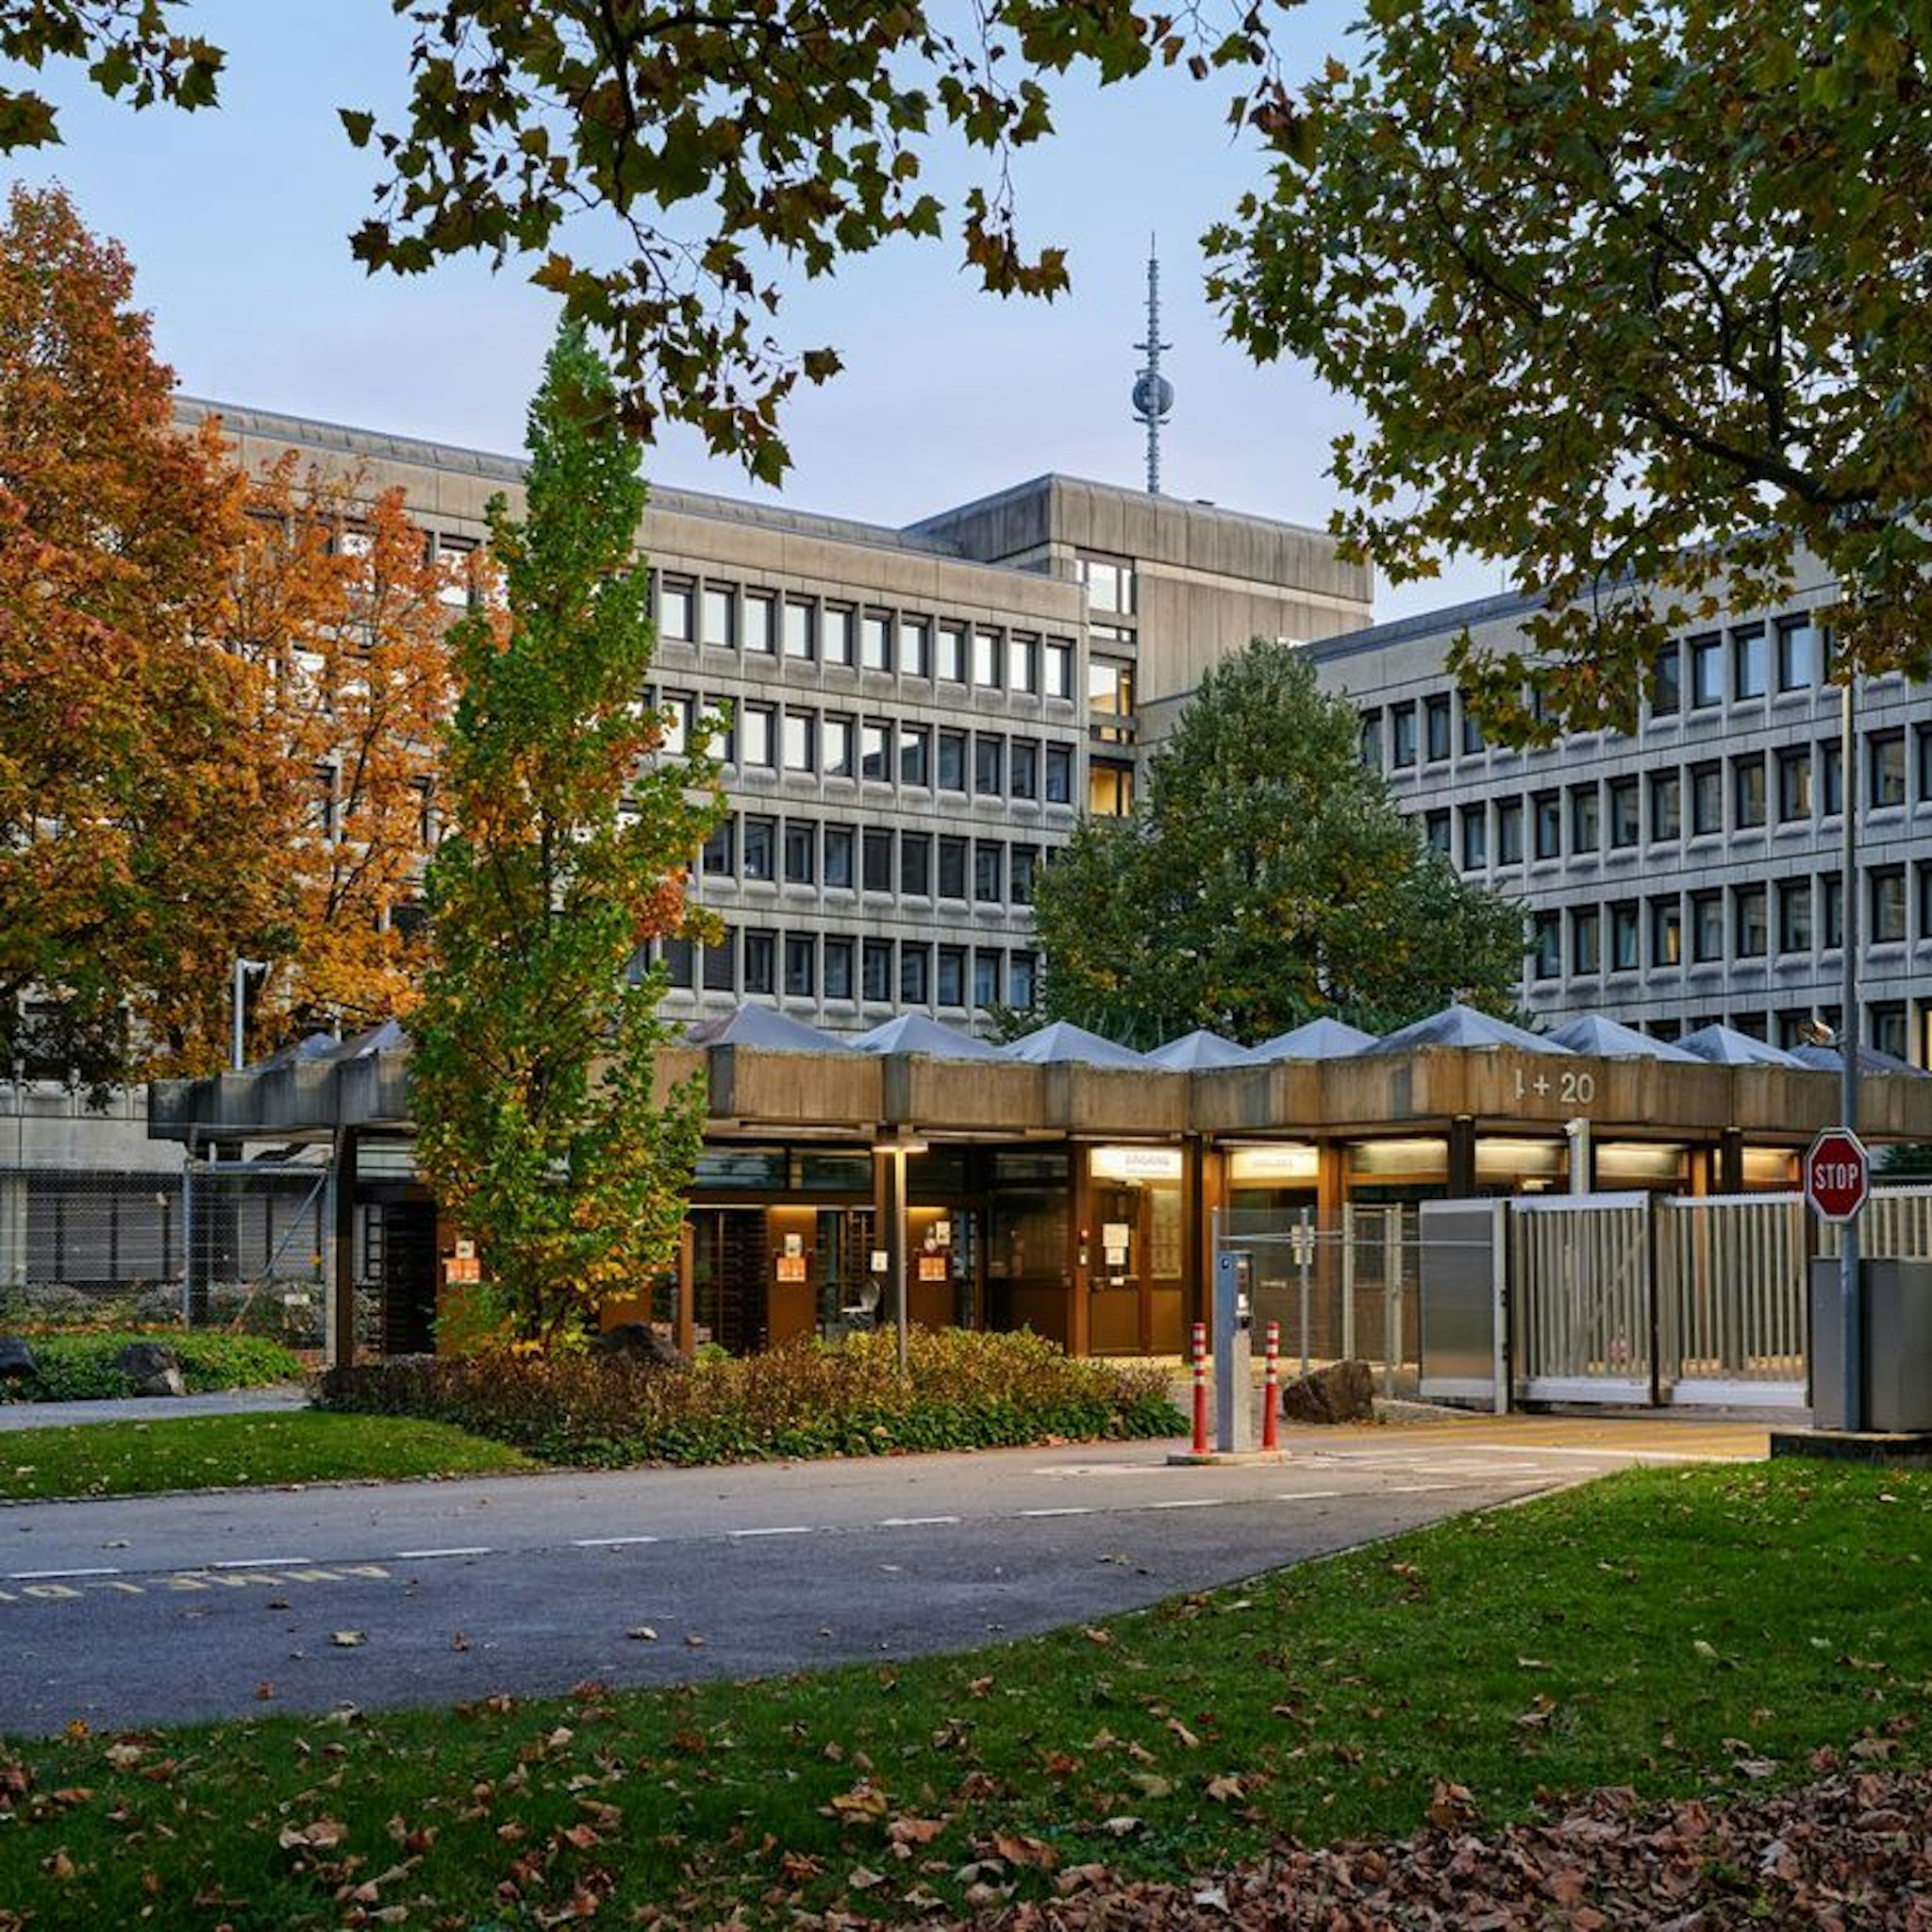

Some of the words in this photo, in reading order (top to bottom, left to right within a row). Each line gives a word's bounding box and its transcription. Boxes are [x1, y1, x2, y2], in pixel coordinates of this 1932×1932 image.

[1532, 1074, 1550, 1096] +
[1559, 1072, 1595, 1104] 20
[1814, 1163, 1858, 1190] STOP
